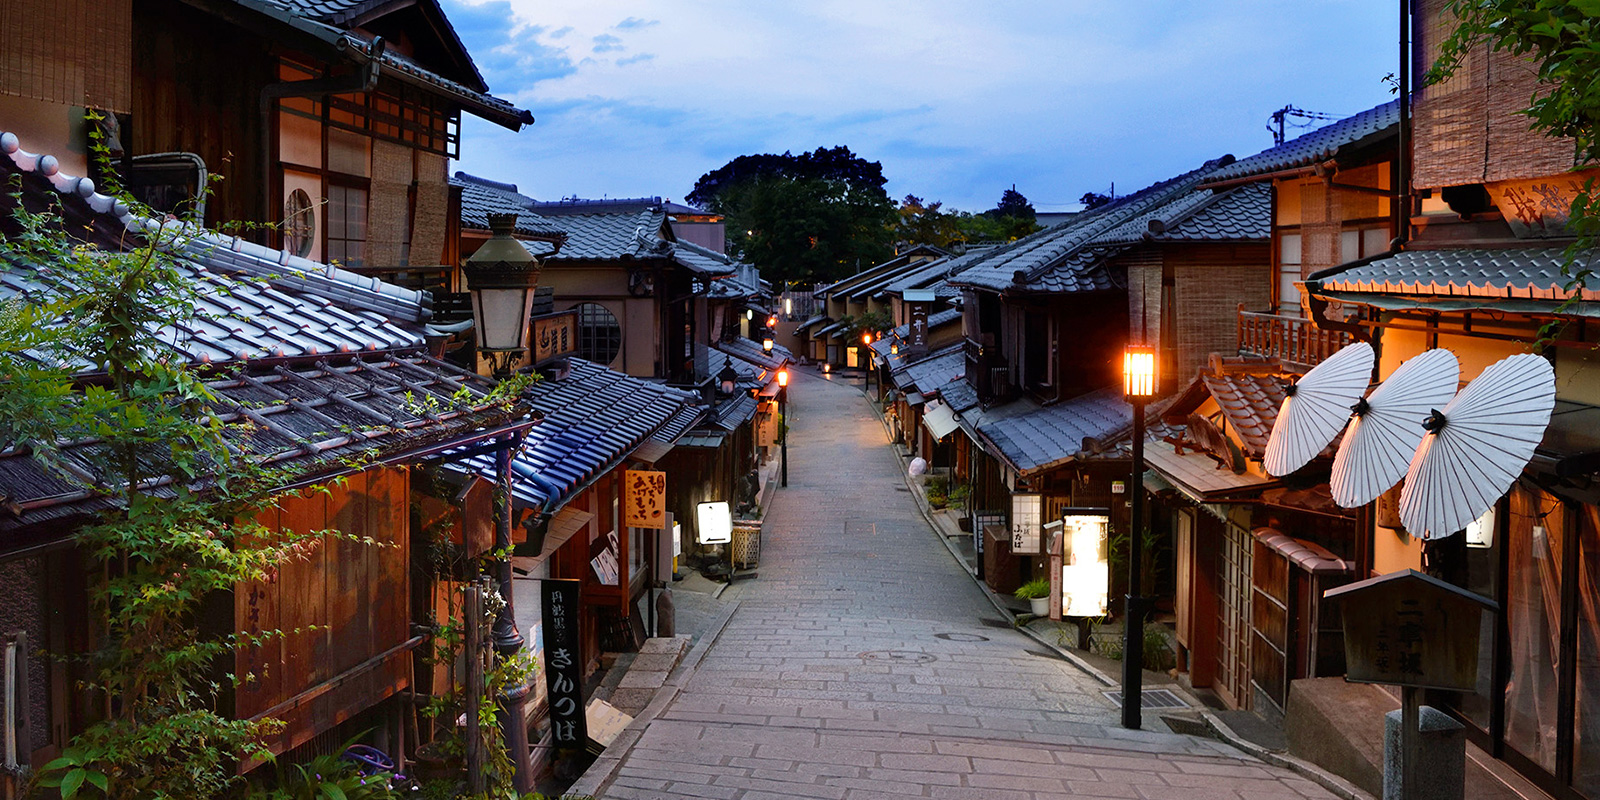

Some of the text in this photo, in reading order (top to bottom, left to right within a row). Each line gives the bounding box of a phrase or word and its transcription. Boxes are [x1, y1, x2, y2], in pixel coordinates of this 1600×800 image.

[633, 476, 649, 520] あげもち
[648, 475, 657, 508] もっちり
[1013, 524, 1024, 548] ふたば
[551, 648, 577, 742] きんつば
